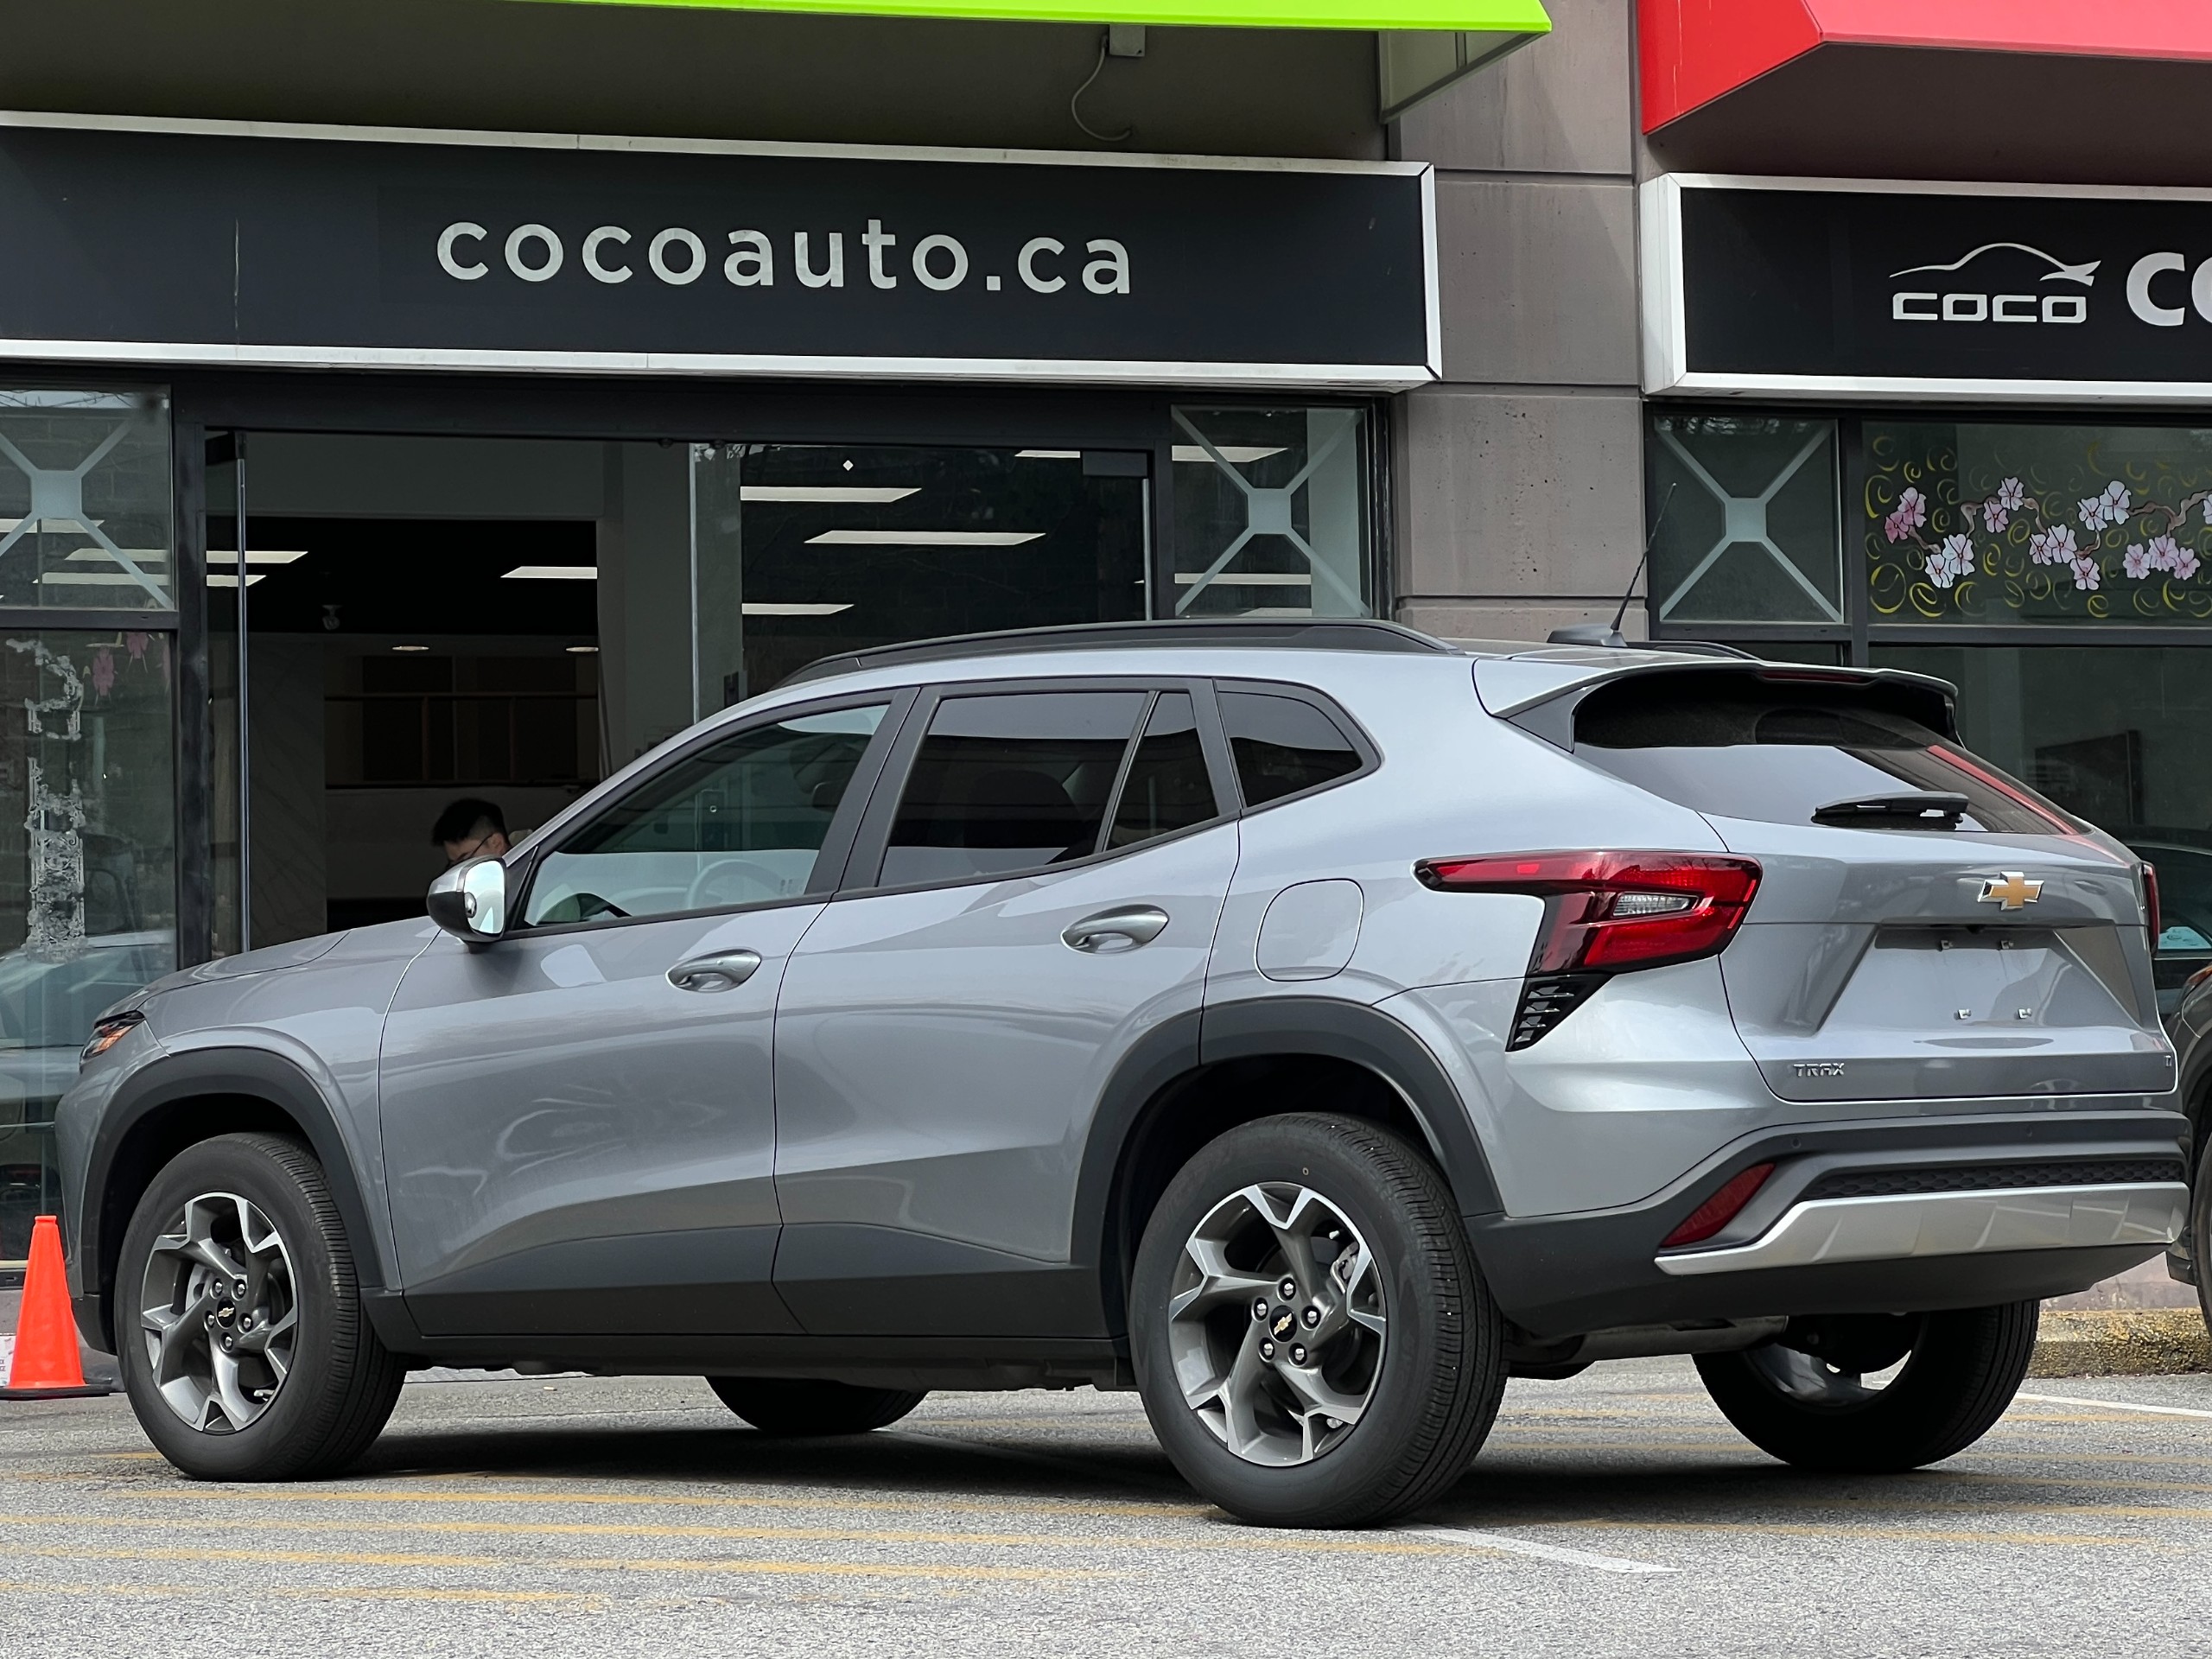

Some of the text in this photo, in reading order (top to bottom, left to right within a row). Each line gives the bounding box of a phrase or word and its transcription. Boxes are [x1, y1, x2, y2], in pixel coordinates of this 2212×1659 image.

[436, 219, 1130, 295] cocoauto.ca
[1892, 292, 2087, 324] COCO
[2126, 251, 2212, 327] C
[1793, 1062, 1845, 1077] TRAX
